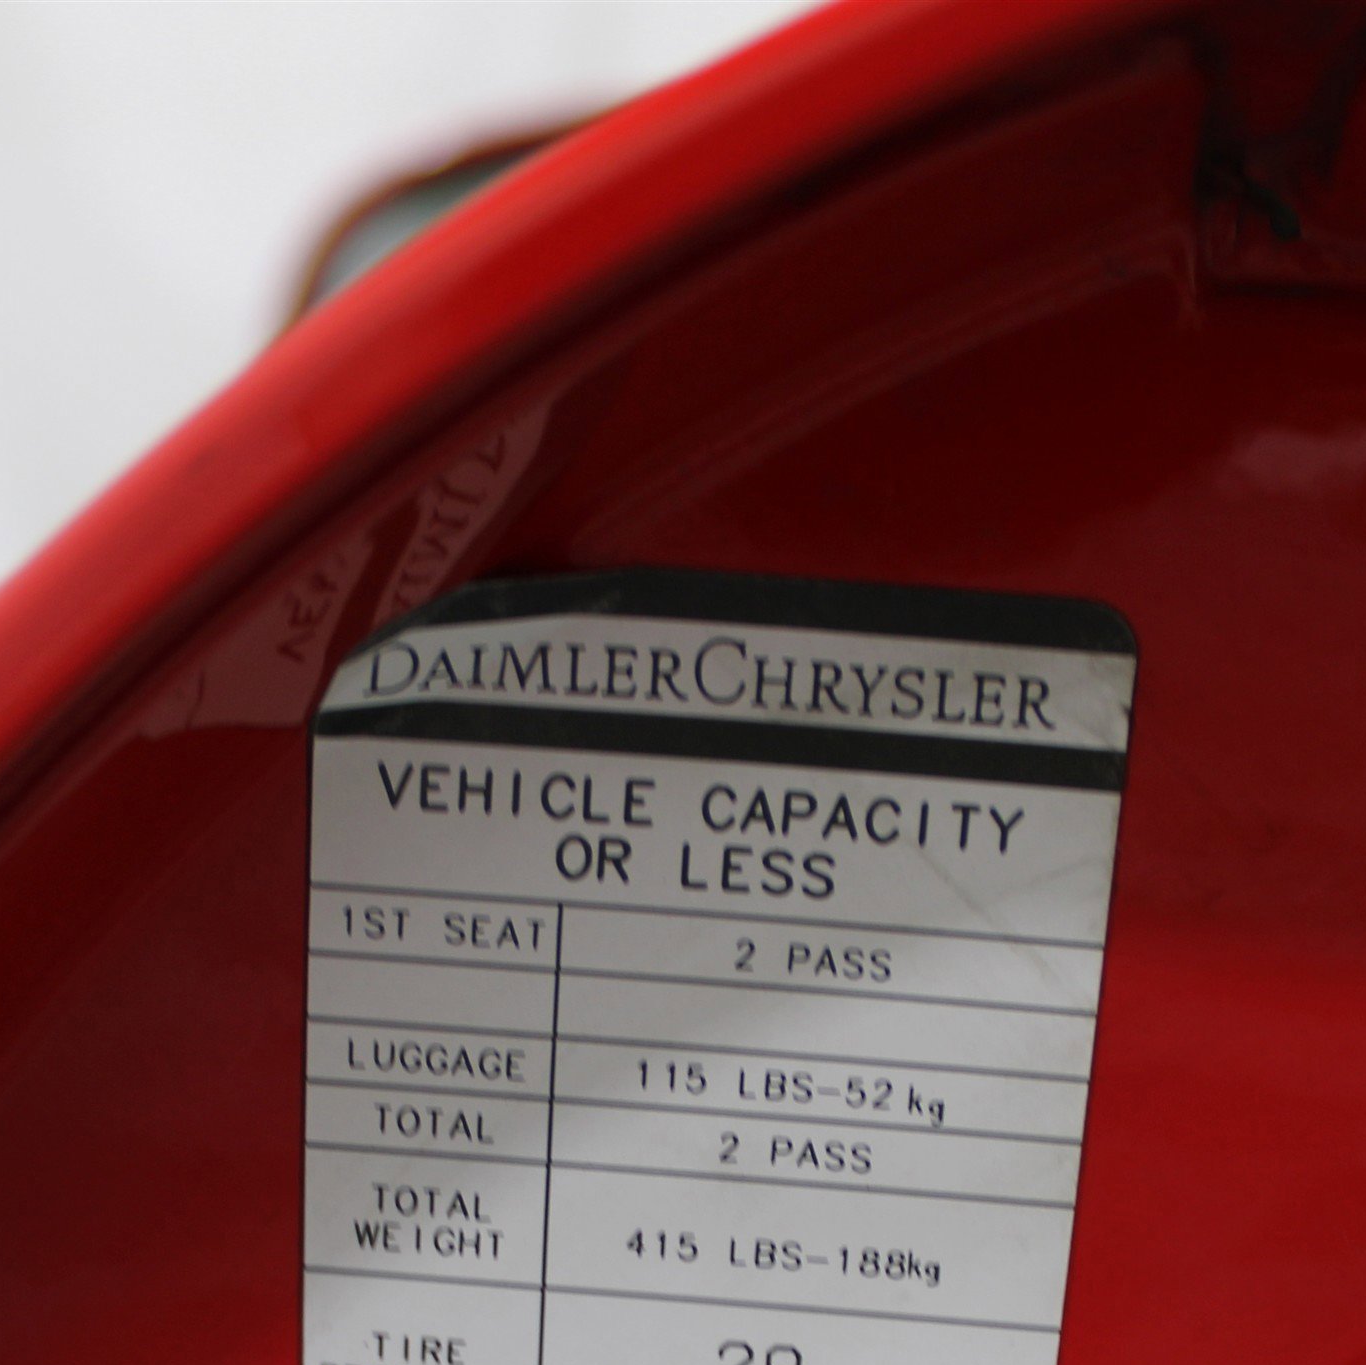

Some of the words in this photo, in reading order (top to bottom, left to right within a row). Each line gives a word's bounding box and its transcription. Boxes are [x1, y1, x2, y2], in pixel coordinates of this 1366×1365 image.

[377, 761, 655, 826] VEHICLE
[701, 783, 1024, 854] CAPACITY
[555, 833, 631, 884] OR
[680, 842, 836, 900] LESS
[342, 905, 409, 940] 1ST
[444, 911, 544, 951] SEAT
[734, 940, 755, 973] 2
[788, 946, 892, 982] PASS
[347, 1038, 525, 1082] LUGGAGE
[636, 1059, 707, 1095] 115
[374, 1103, 495, 1145] TOTAL
[718, 1132, 740, 1164] 2
[771, 1137, 873, 1175] PASS
[372, 1184, 493, 1223] TOTAL
[354, 1220, 505, 1262] WEIGHT
[625, 1229, 699, 1264] 415
